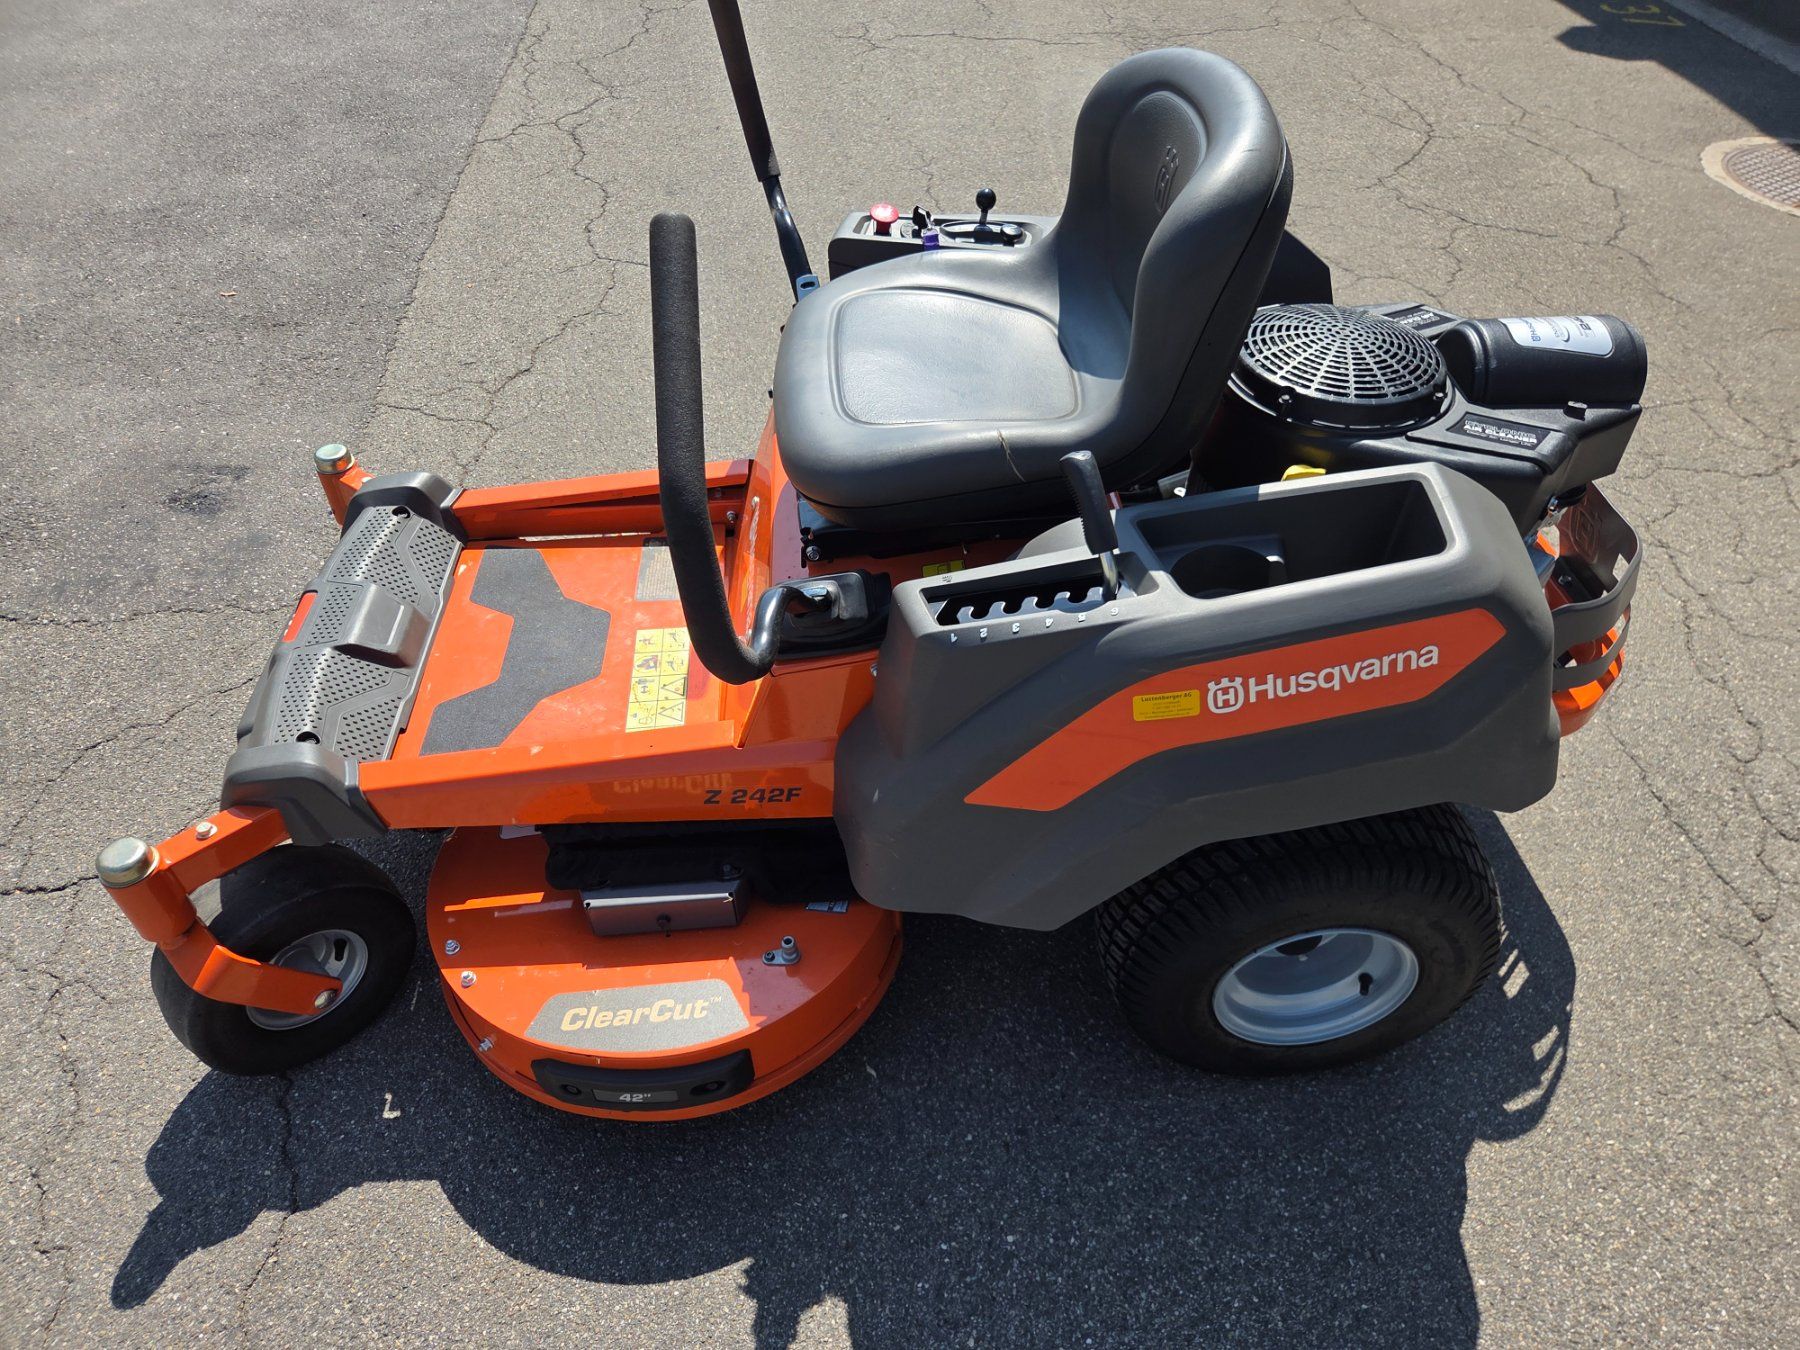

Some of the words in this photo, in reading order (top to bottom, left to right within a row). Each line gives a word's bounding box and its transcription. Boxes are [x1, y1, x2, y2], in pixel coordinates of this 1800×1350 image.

[1485, 429, 1537, 444] CLEANER
[1249, 645, 1439, 703] Husqvarna
[704, 789, 722, 804] Z
[731, 787, 801, 804] 242F
